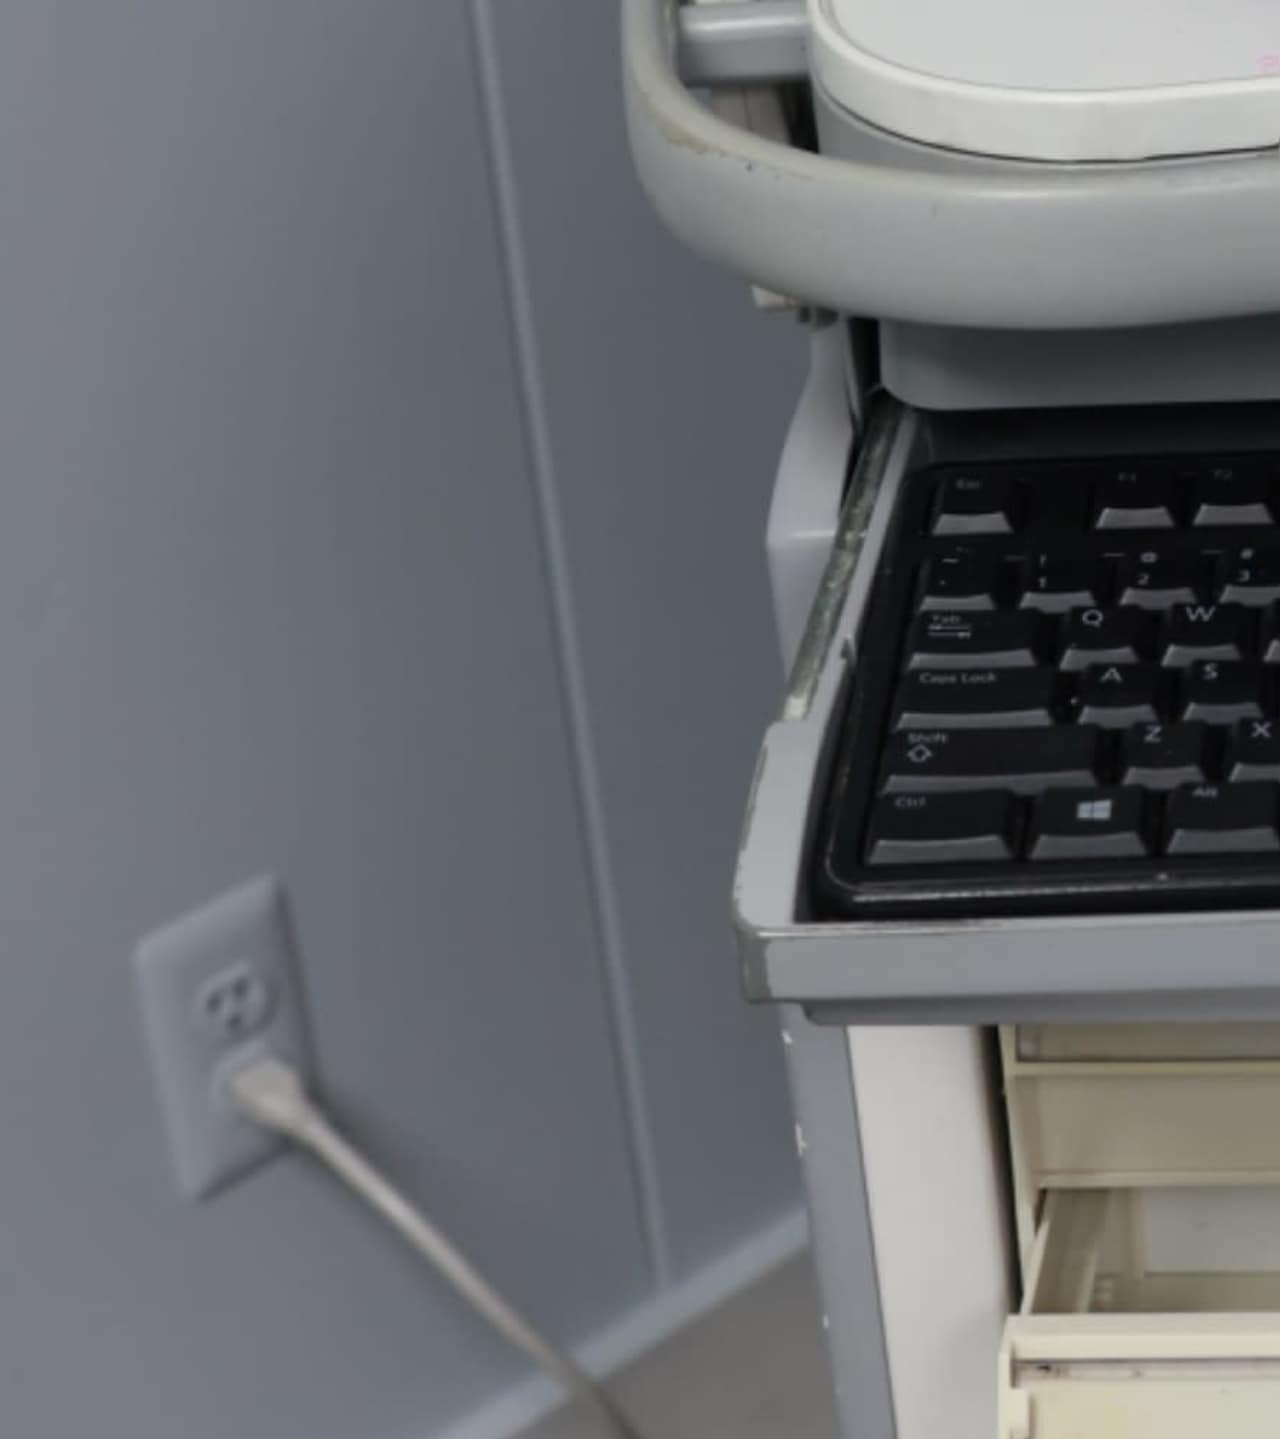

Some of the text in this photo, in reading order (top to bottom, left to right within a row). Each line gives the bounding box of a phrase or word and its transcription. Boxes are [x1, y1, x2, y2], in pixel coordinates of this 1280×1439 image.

[1136, 573, 1152, 587] 2
[1081, 609, 1105, 628] Q
[1185, 606, 1217, 622] W
[919, 671, 998, 685] Caps Lock
[1099, 667, 1123, 684] A
[1203, 663, 1219, 680] S
[1143, 724, 1163, 743] Z
[1249, 721, 1273, 739] X
